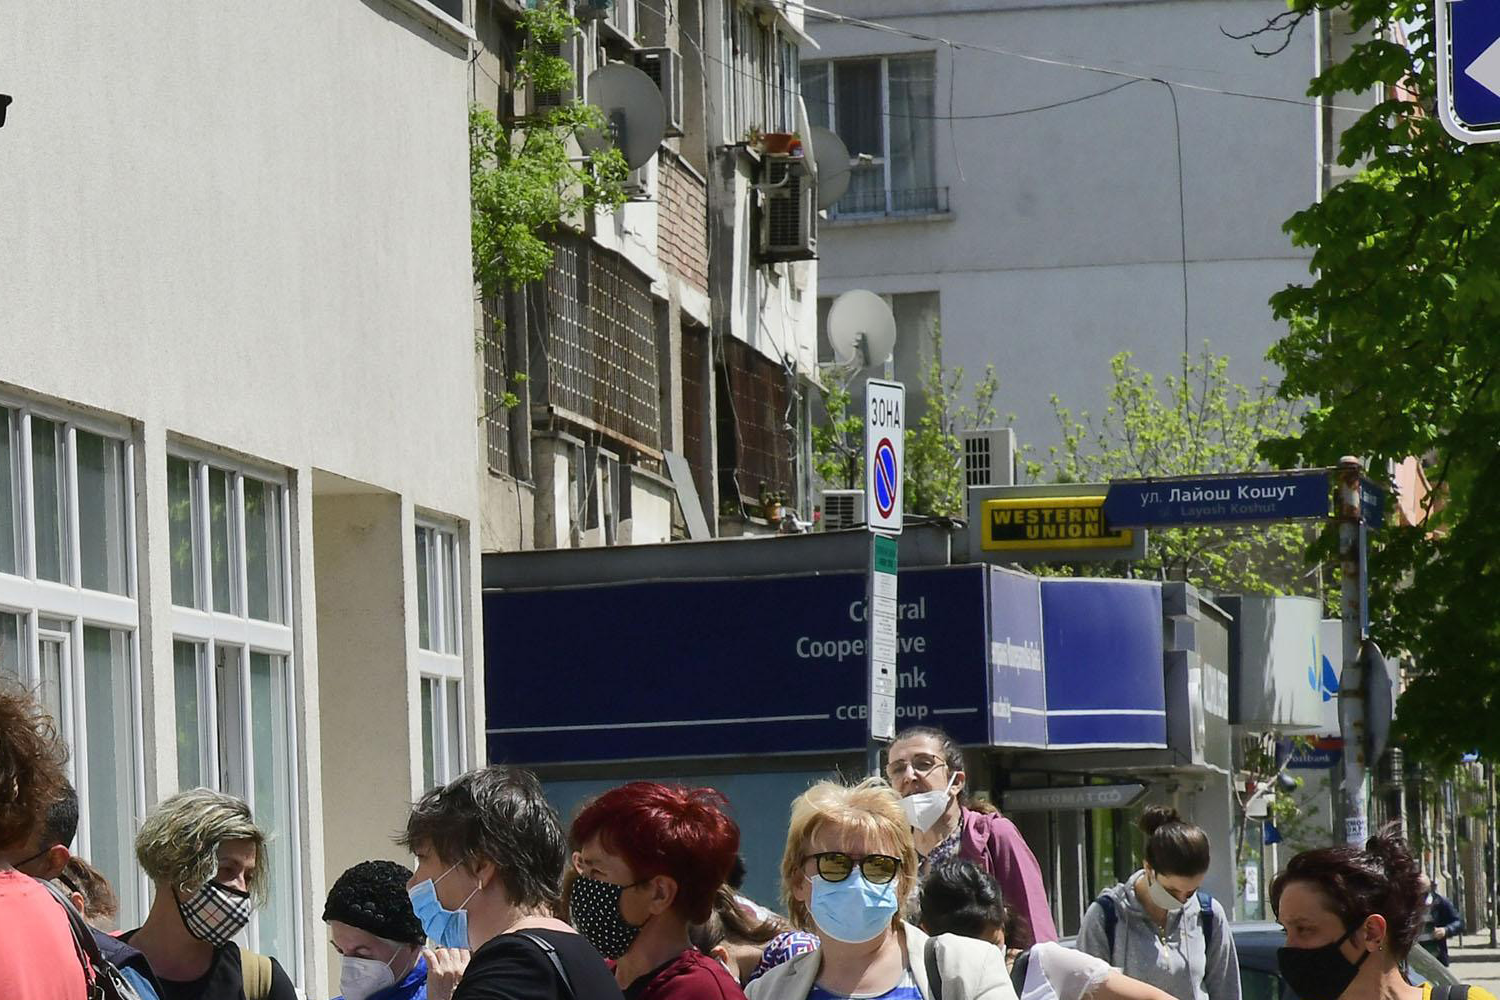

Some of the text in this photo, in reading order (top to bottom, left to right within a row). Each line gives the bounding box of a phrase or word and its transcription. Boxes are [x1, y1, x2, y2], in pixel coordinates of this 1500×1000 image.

[871, 397, 901, 429] ЗОНА
[1140, 484, 1297, 507] ул. Лайош Кошут
[993, 509, 1099, 525] WESTERN
[1230, 502, 1276, 514] Koshut
[1026, 524, 1099, 538] UNION
[849, 596, 926, 623] Cral
[796, 632, 926, 662] Coopeive
[836, 705, 868, 720] CCB
